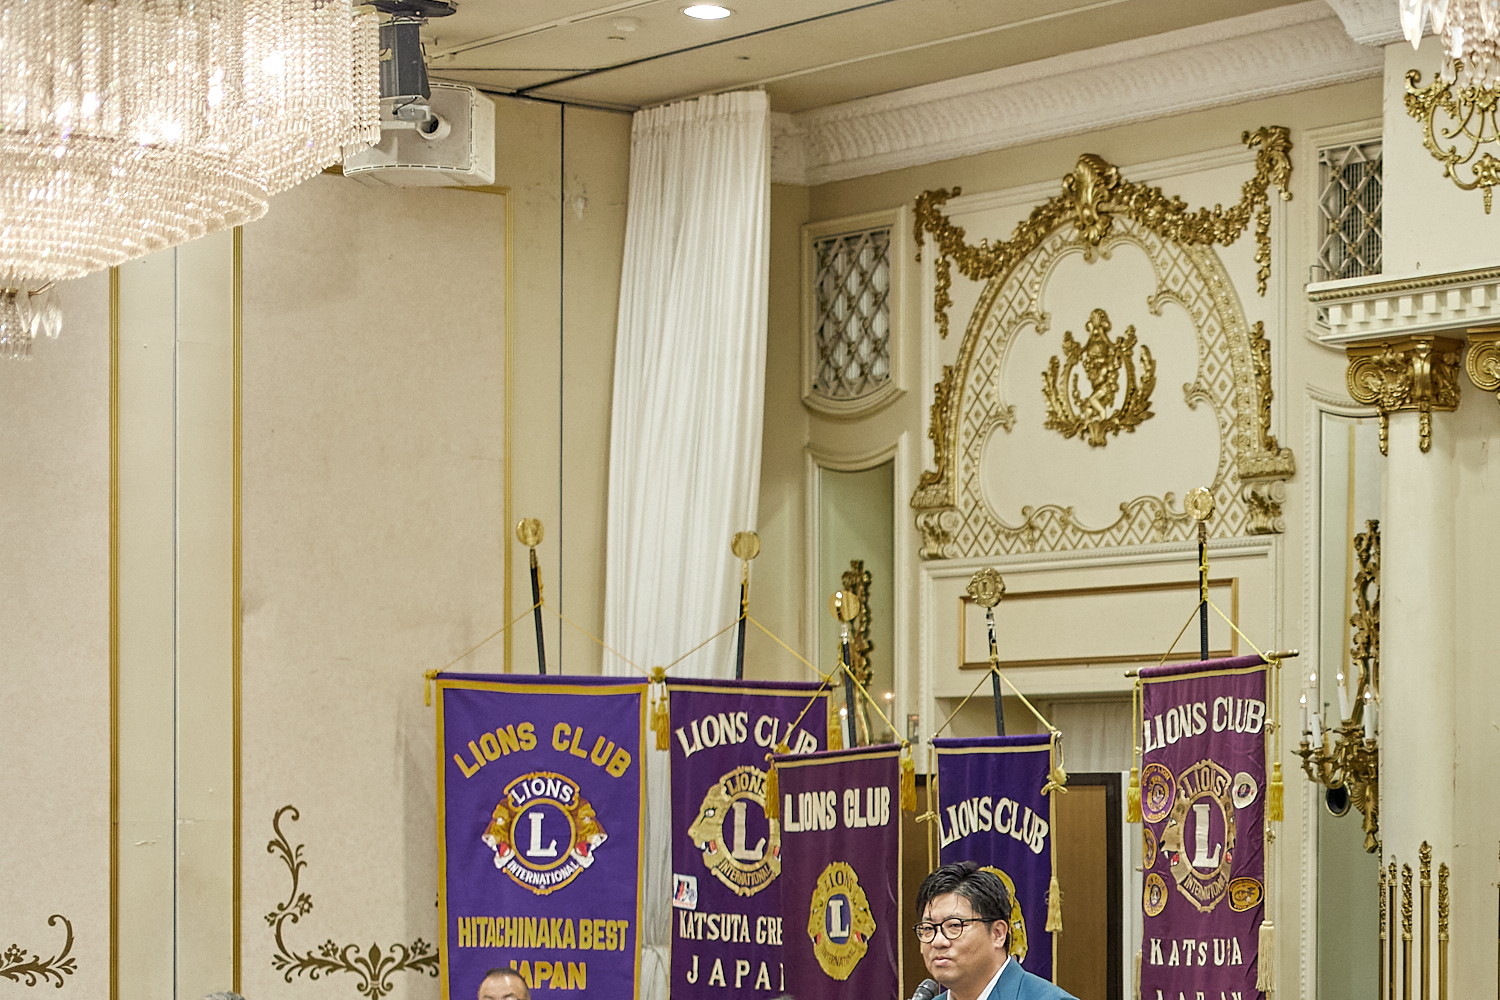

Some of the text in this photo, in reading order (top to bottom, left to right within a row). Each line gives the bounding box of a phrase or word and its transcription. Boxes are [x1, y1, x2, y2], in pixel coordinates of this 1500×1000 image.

[675, 711, 749, 759] LIONS
[1143, 695, 1266, 754] LIONS CLUB
[453, 721, 632, 779] LIONS CLUB
[510, 777, 574, 805] LIONS
[1182, 772, 1225, 797] LIONS
[784, 786, 891, 833] LIONS CLUB
[939, 795, 1049, 854] LIONS CLUB
[526, 811, 558, 857] L
[731, 800, 767, 860] L
[1192, 803, 1221, 868] L
[507, 858, 580, 886] INTERNATIONAL
[718, 859, 773, 886] INTERNATIONAL
[824, 869, 855, 891] LIONS
[1184, 873, 1225, 902] INTERNATIONAL
[457, 916, 629, 951] HITACHINAKA BEST
[678, 910, 751, 944] KATSUTA
[829, 899, 849, 938] L
[1150, 936, 1243, 967] KATSUA
[686, 954, 785, 992] JAPA
